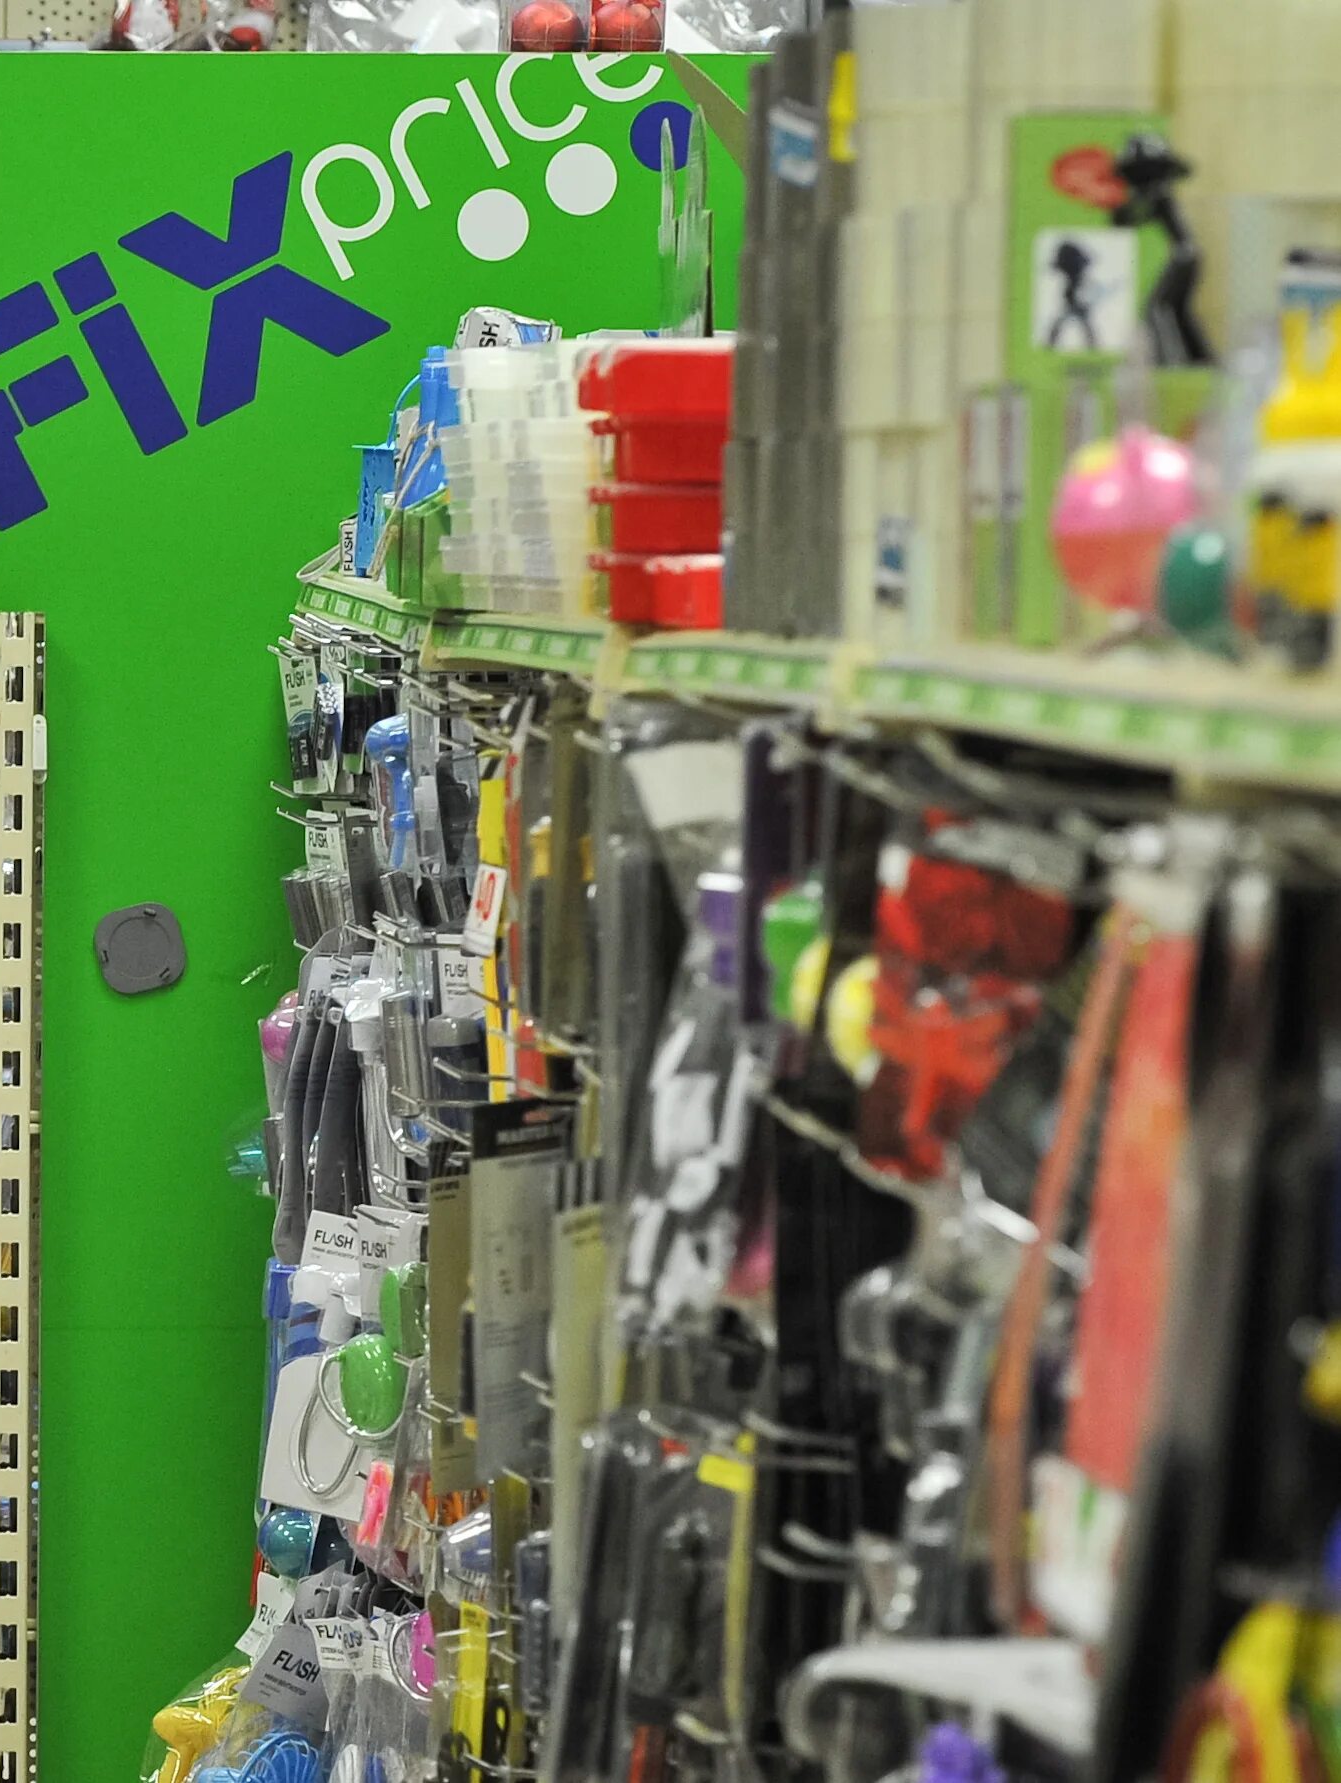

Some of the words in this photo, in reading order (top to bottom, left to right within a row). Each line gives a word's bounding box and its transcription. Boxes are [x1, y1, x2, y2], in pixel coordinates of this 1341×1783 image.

[343, 531, 354, 572] FLASH
[314, 1229, 354, 1250] FLASH
[315, 1625, 342, 1640] FLA
[272, 1649, 321, 1683] FLASH
